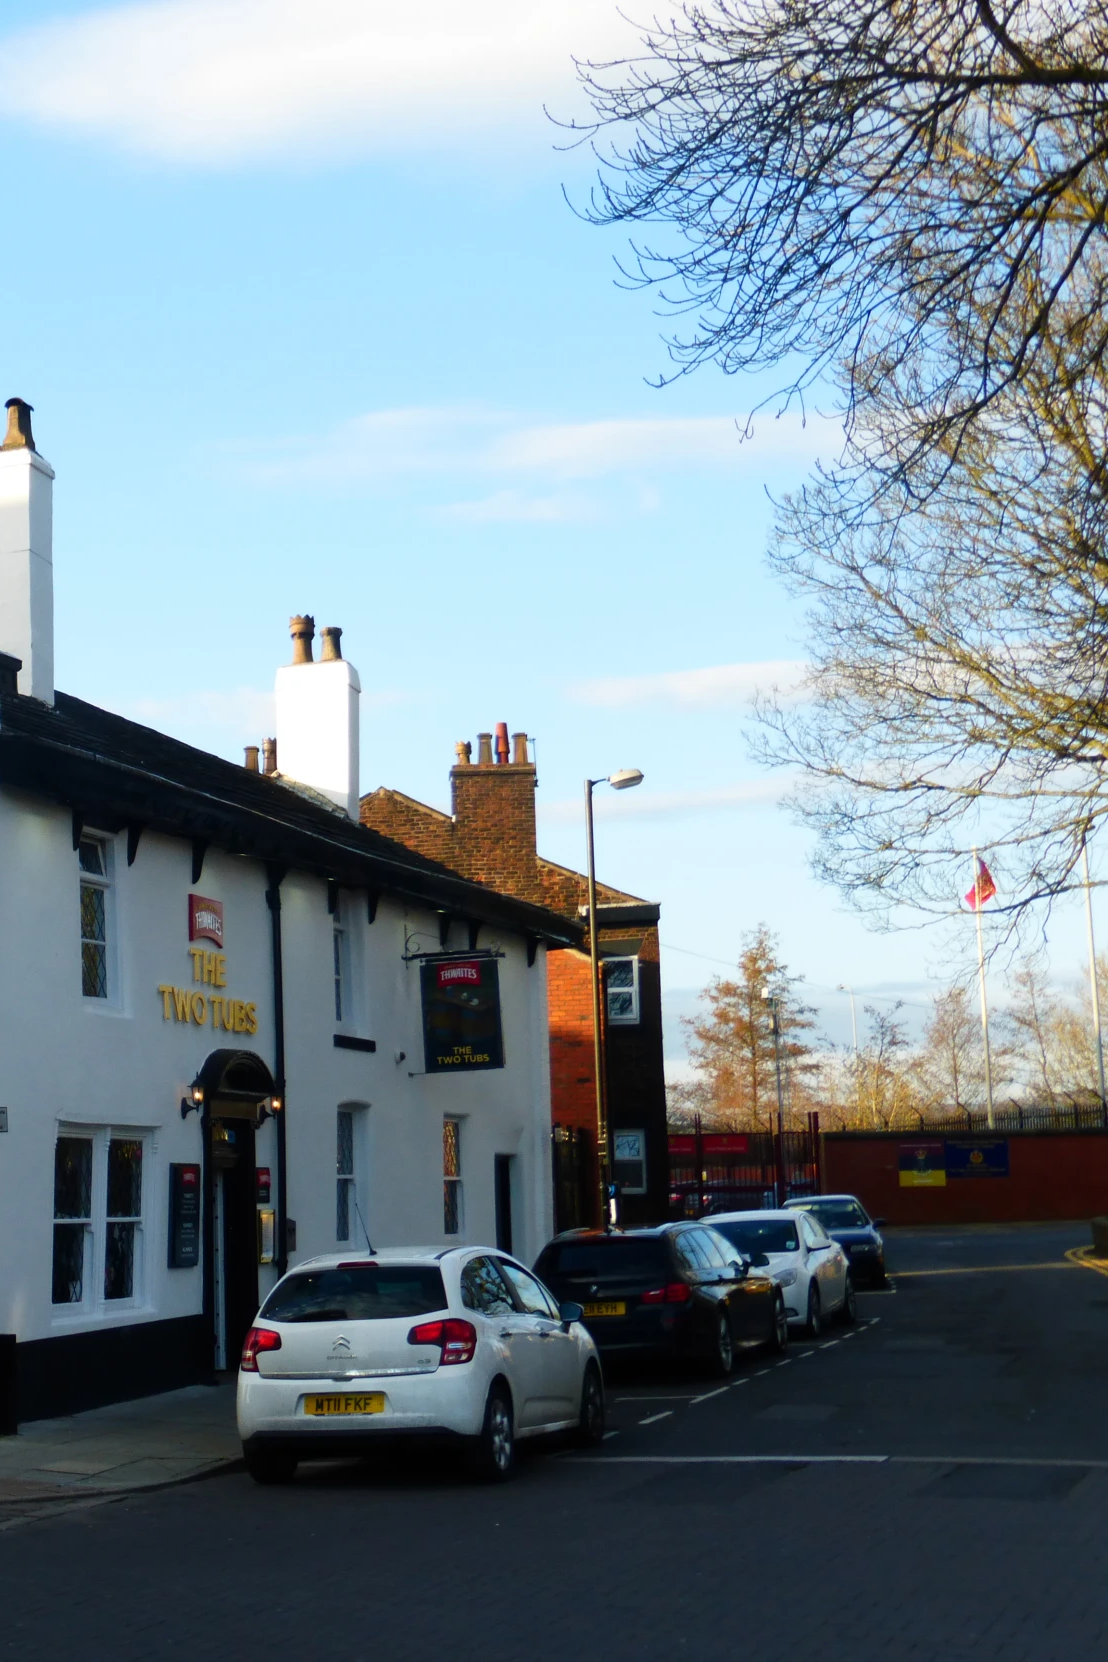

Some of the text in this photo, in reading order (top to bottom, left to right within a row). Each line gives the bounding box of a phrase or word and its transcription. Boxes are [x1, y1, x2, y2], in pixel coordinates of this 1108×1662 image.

[195, 911, 222, 935] THWAITES
[189, 948, 227, 987] THE
[440, 968, 477, 980] THWAITES
[159, 984, 258, 1034] TWO TUBS
[453, 1046, 472, 1054] THE
[437, 1054, 490, 1064] TWO TUBS
[597, 1303, 617, 1314] EYH
[315, 1397, 373, 1412] MT11 FKF
